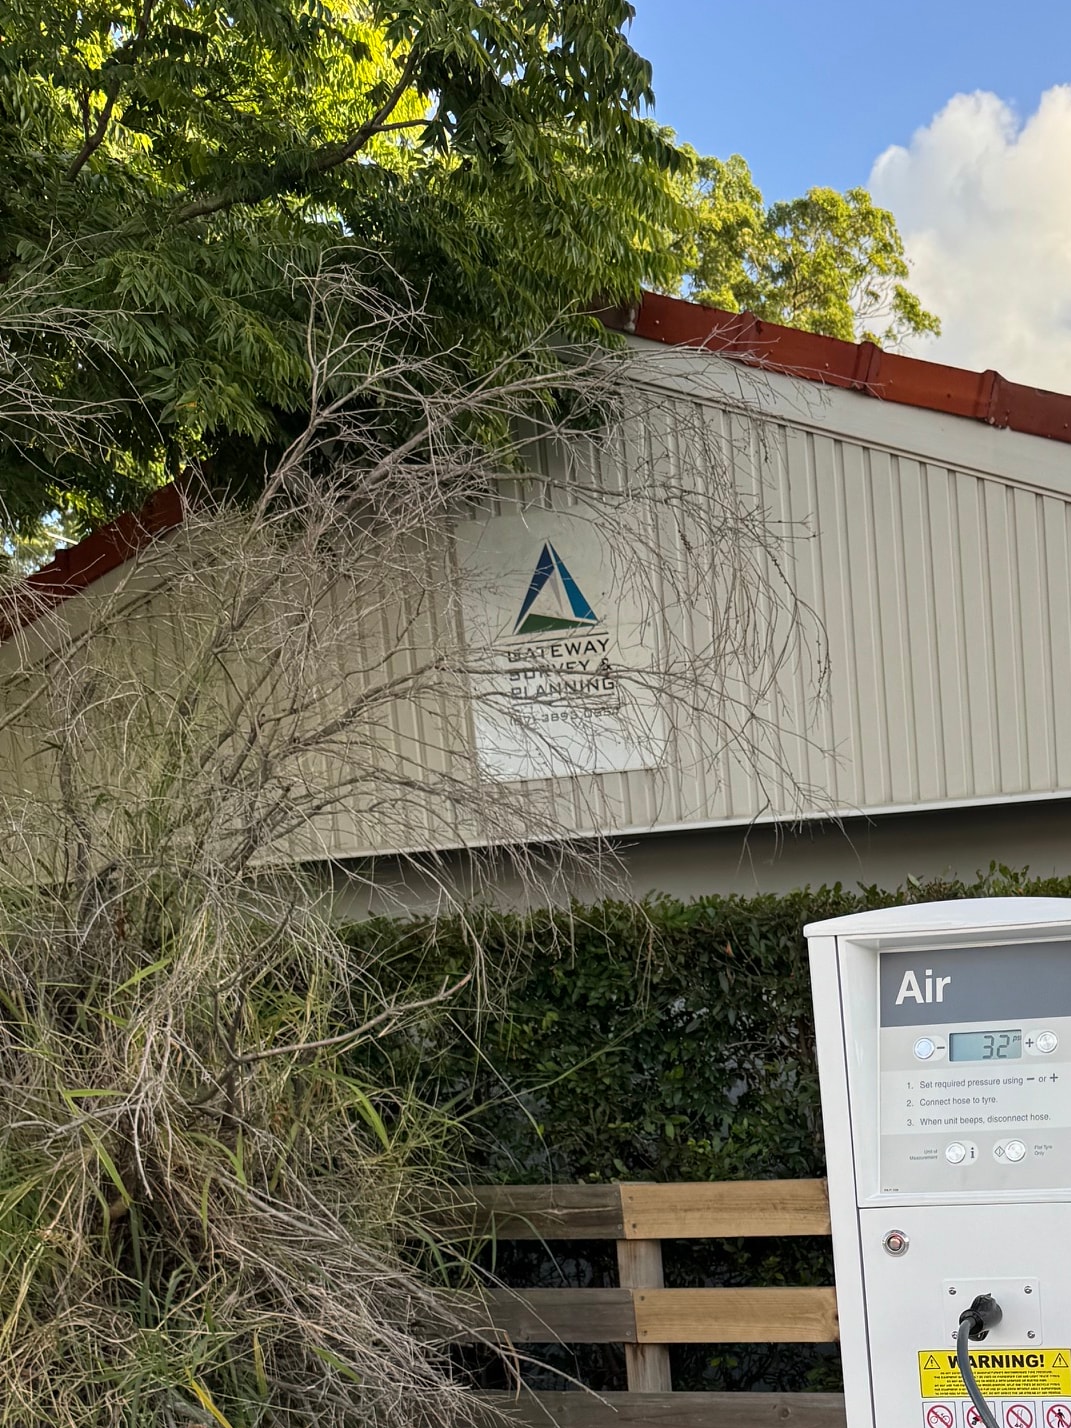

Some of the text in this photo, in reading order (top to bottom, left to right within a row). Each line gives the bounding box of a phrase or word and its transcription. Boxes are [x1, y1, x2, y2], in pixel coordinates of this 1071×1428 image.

[508, 639, 609, 662] GATEWAY
[511, 679, 615, 698] PLANNING
[895, 969, 951, 1005] Air
[982, 1034, 1010, 1059] 32
[919, 1080, 933, 1089] Set
[934, 1079, 966, 1089] required
[967, 1078, 1001, 1088] pressure
[1002, 1076, 1024, 1086] using
[919, 1097, 951, 1107] Connect
[952, 1096, 971, 1105] hose
[981, 1096, 998, 1105] tyre.
[906, 1112, 1051, 1127] 3. When unit beeps, disconnect hose.
[947, 1354, 1045, 1369] WARNING!
